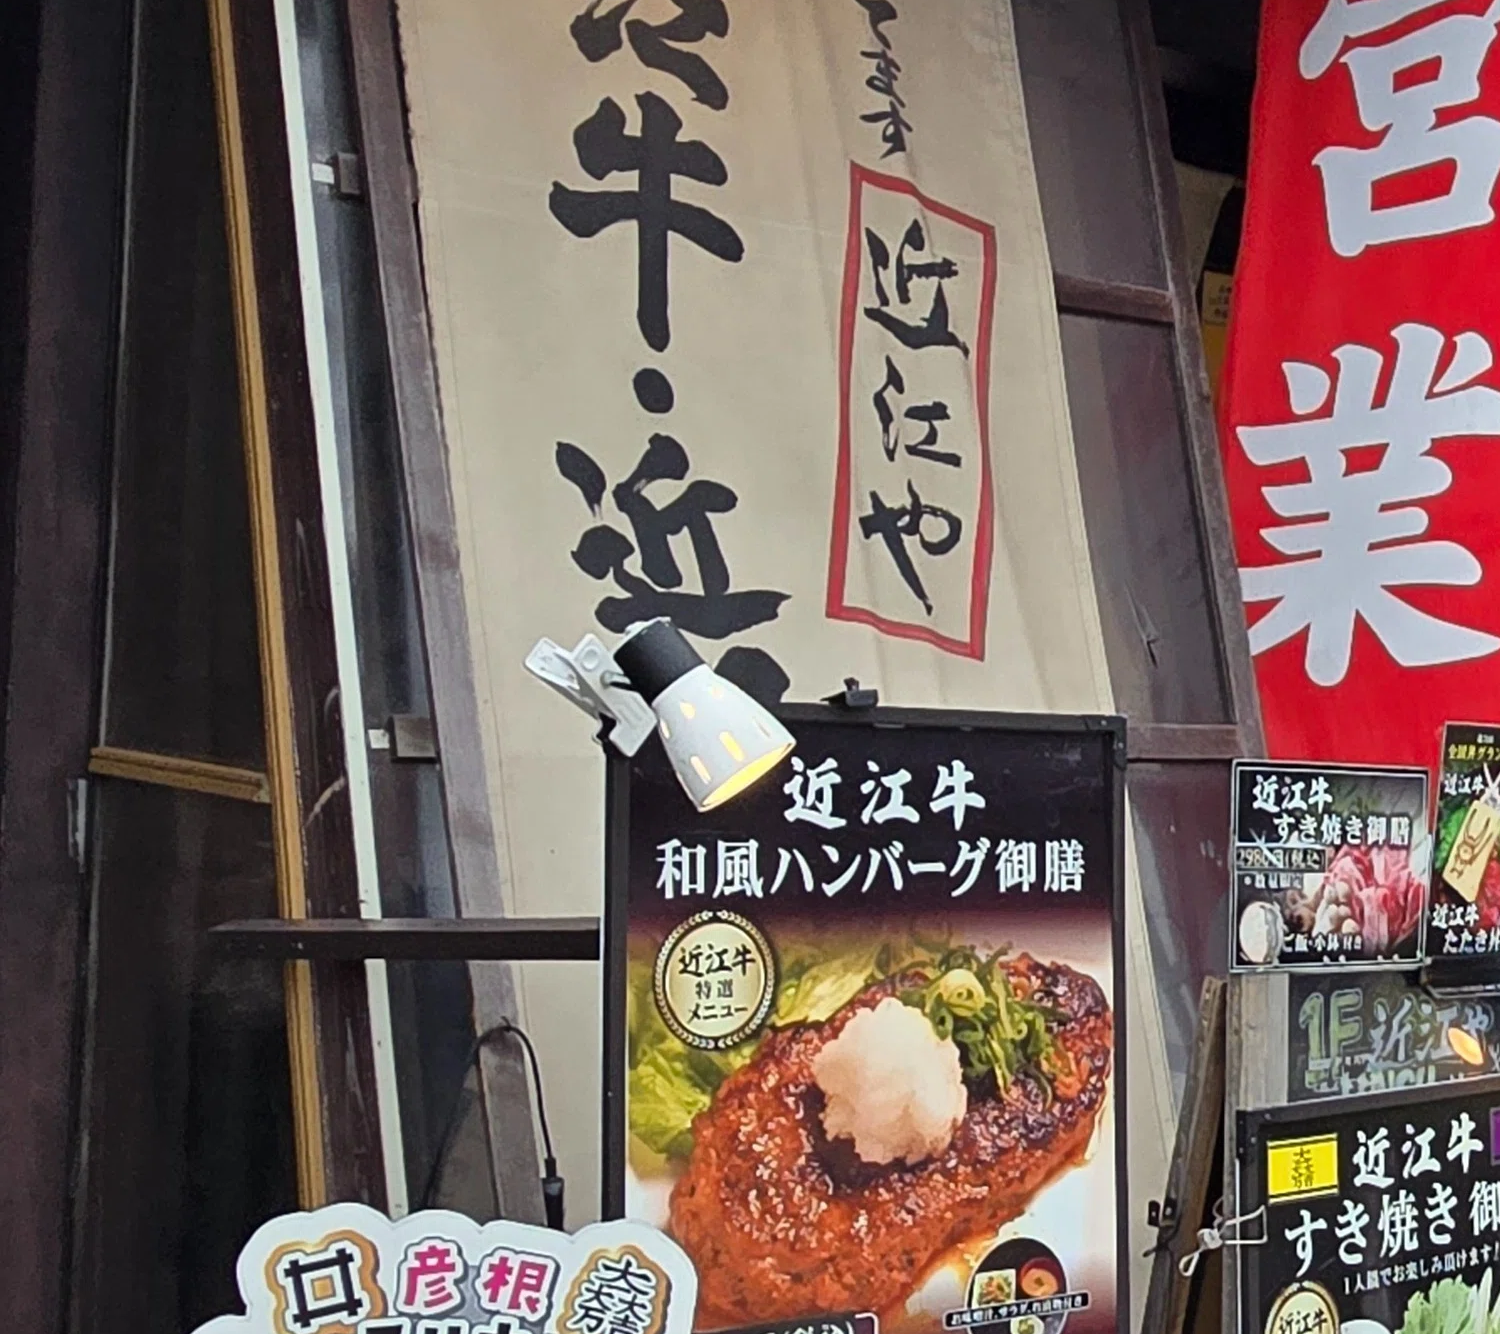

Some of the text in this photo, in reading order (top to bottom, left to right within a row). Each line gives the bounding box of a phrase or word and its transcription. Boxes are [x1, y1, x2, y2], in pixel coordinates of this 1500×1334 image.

[857, 218, 970, 614] 近江や
[784, 756, 986, 831] 近江牛
[1253, 774, 1333, 814] 近江牛
[1272, 814, 1410, 847] すき焼き御膳
[655, 837, 1086, 900] 和風ハンバーグ御膳
[1430, 903, 1480, 927] 近江牛
[678, 945, 757, 978] 近江牛
[694, 979, 735, 1002] 特選
[687, 1002, 749, 1023] メニュー
[1353, 1112, 1483, 1189] 近江牛
[402, 1242, 551, 1316] 彦根
